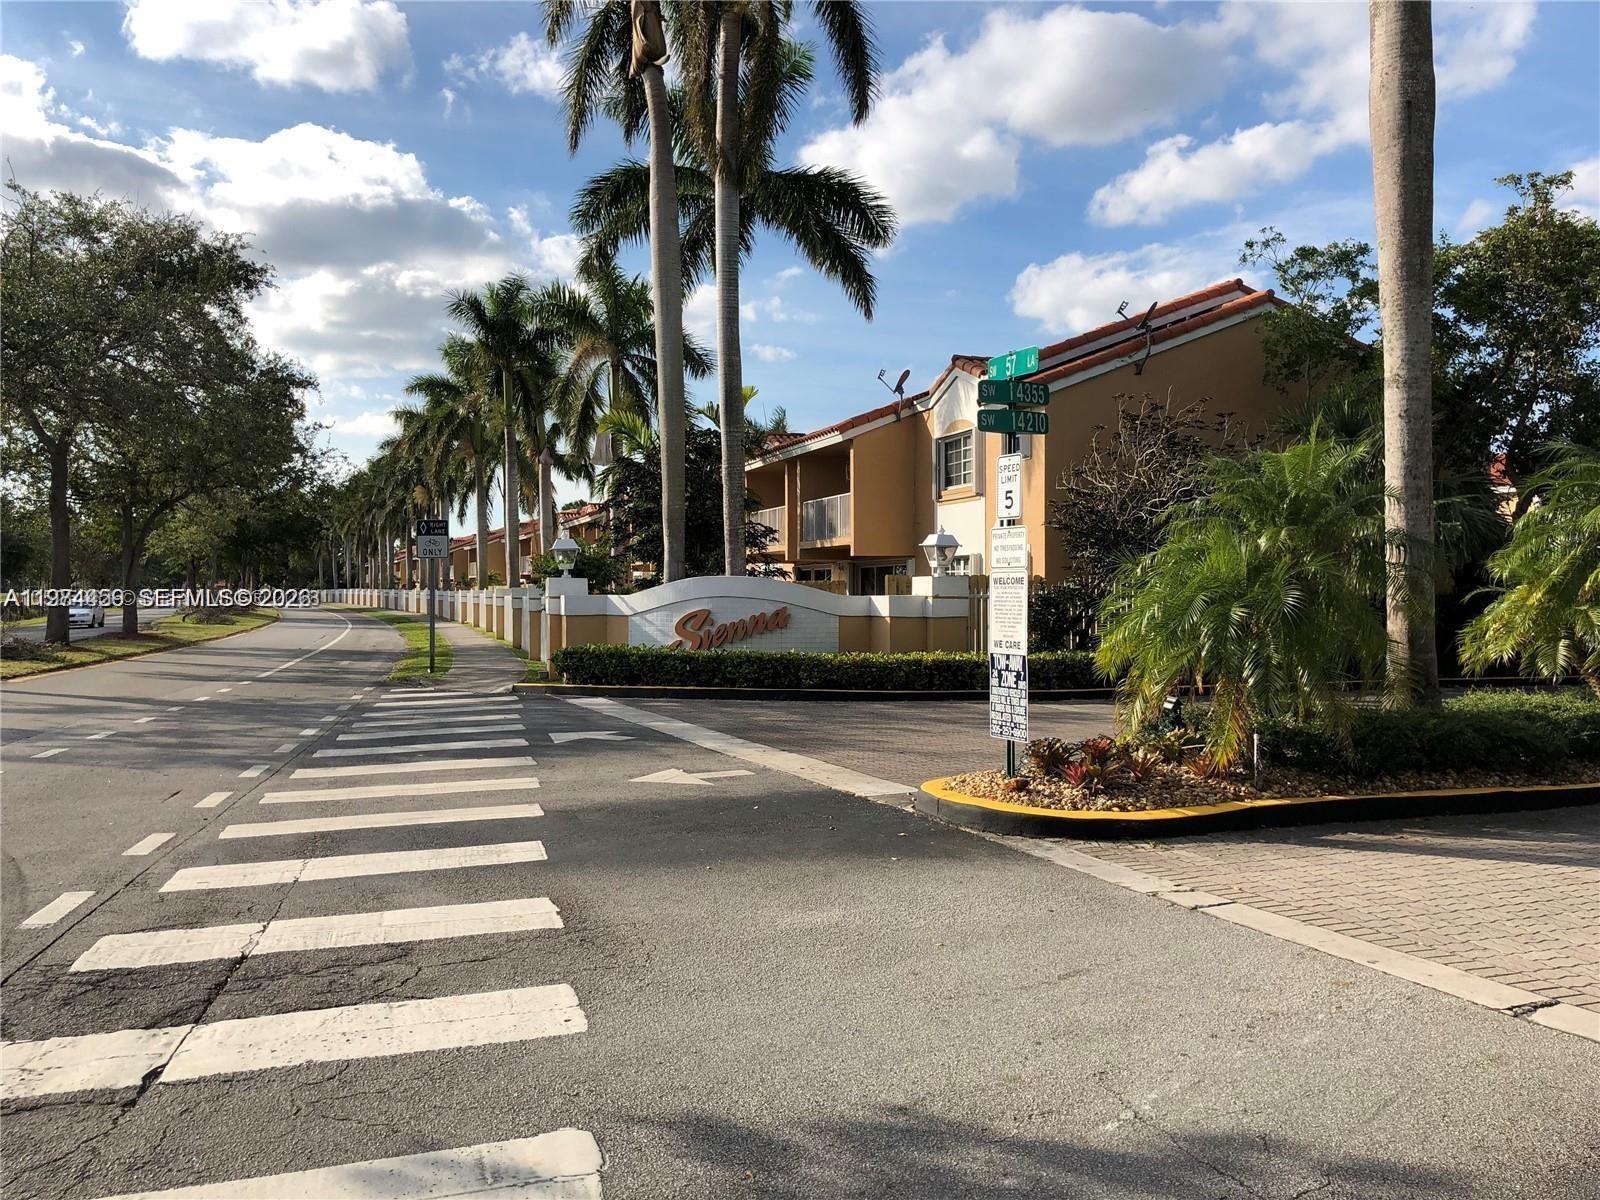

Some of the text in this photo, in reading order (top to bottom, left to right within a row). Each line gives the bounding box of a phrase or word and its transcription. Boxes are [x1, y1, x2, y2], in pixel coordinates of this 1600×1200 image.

[1006, 355, 1016, 376] 57
[1026, 354, 1035, 368] LA
[982, 382, 1044, 403] SW 14355
[981, 412, 1046, 432] SW 14210
[999, 463, 1020, 473] SPEED
[1001, 475, 1018, 484] LIMIT
[1005, 490, 1014, 509] 5
[422, 548, 443, 556] ONLY
[993, 576, 1024, 585] WELCOME
[669, 606, 791, 651] Sienna
[994, 640, 1003, 649] WE
[993, 654, 1022, 671] TOW-AWAY
[1001, 671, 1016, 688] ZONE
